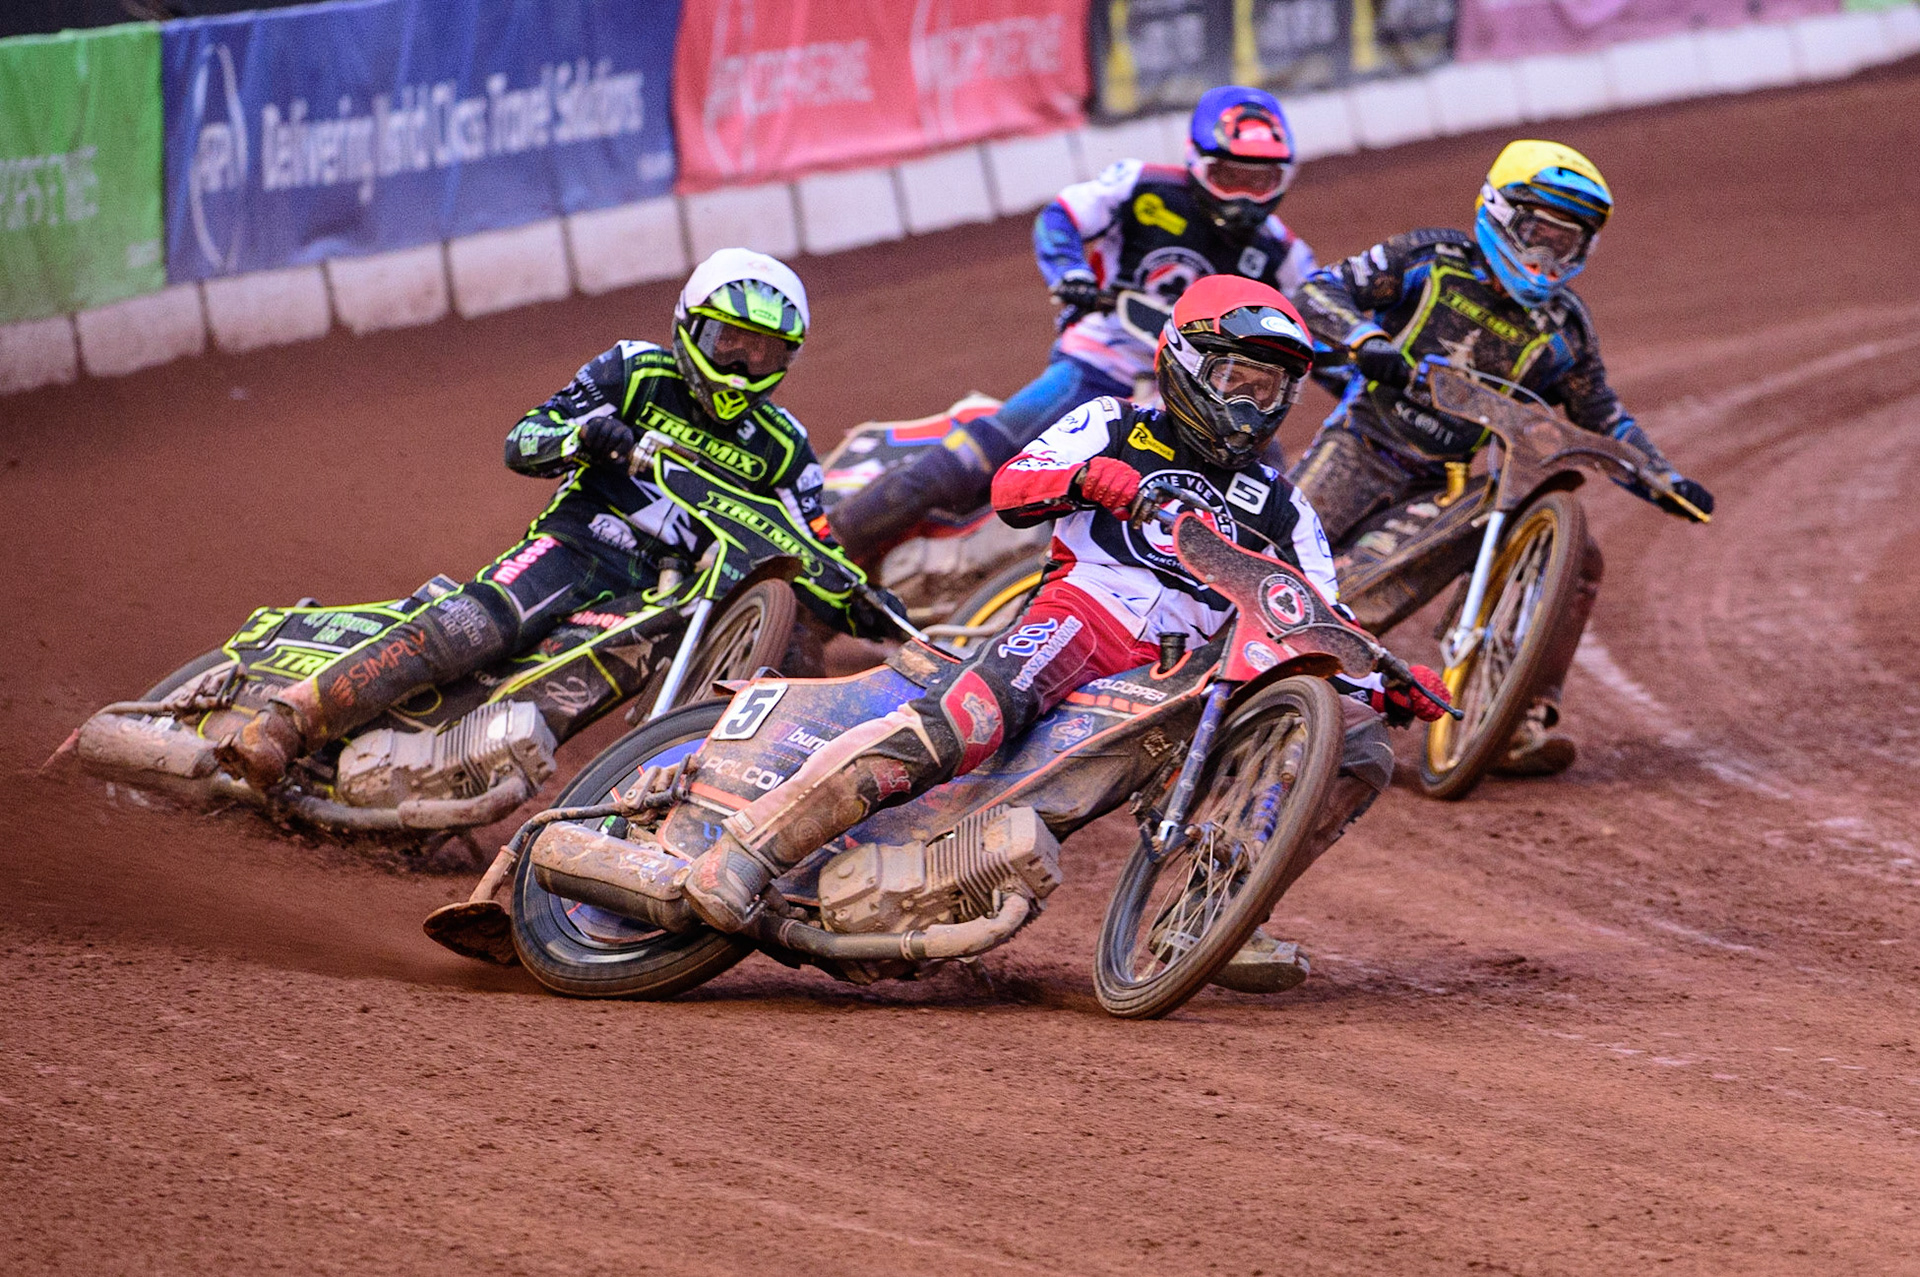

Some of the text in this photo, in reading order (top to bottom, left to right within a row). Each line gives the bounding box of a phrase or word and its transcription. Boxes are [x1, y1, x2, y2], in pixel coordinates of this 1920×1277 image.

[736, 419, 757, 442] 3
[1186, 476, 1214, 501] VUE
[1231, 479, 1263, 506] 5
[235, 612, 285, 643] 3
[273, 651, 328, 676] TR
[349, 629, 426, 690] SIMPLY
[1087, 677, 1169, 702] POLCOPPER
[725, 689, 779, 736] 5
